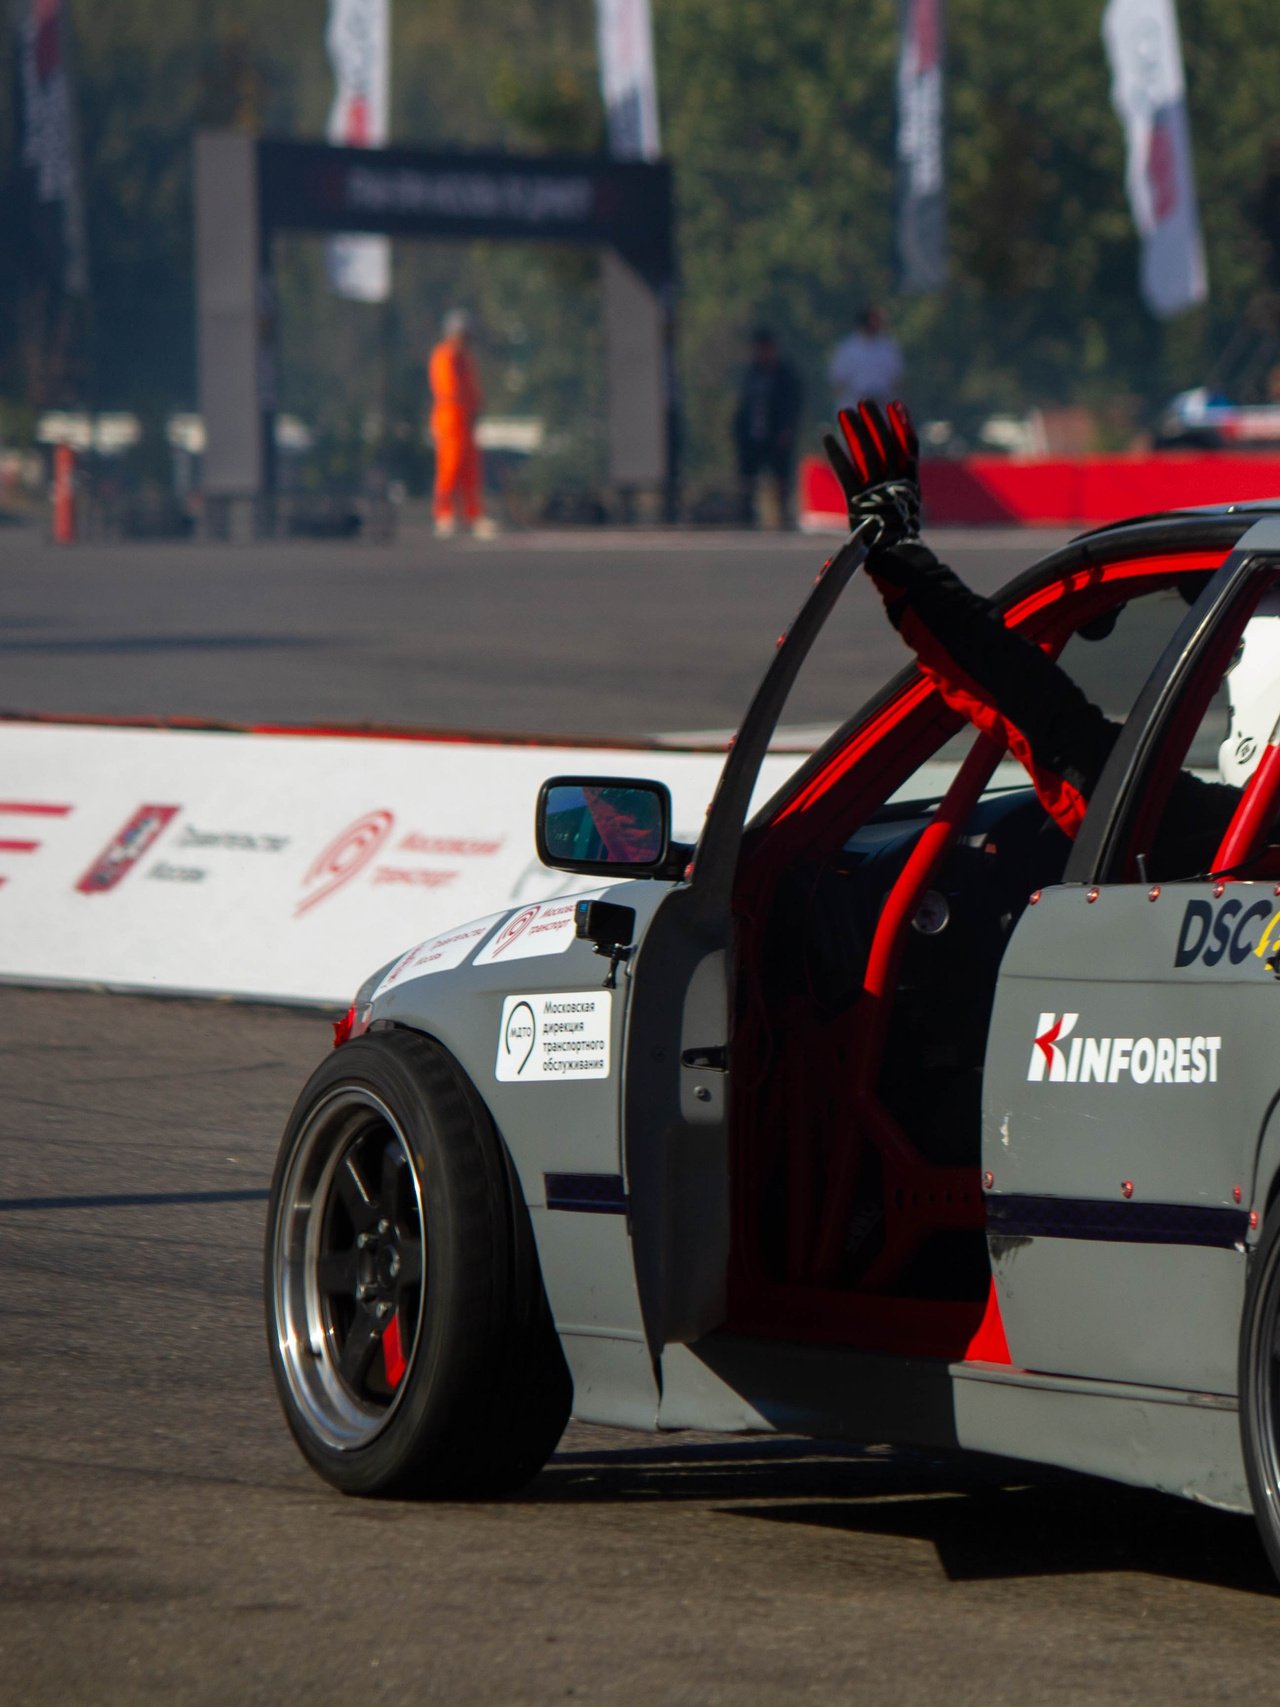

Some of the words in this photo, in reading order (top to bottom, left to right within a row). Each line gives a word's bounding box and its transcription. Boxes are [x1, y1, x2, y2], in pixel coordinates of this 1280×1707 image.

[543, 1001, 595, 1014] Московская
[543, 1022, 584, 1036] дирекция
[543, 1040, 604, 1055] транспортного
[1027, 1012, 1222, 1084] KINFOREST
[543, 1057, 604, 1074] обслуживания
